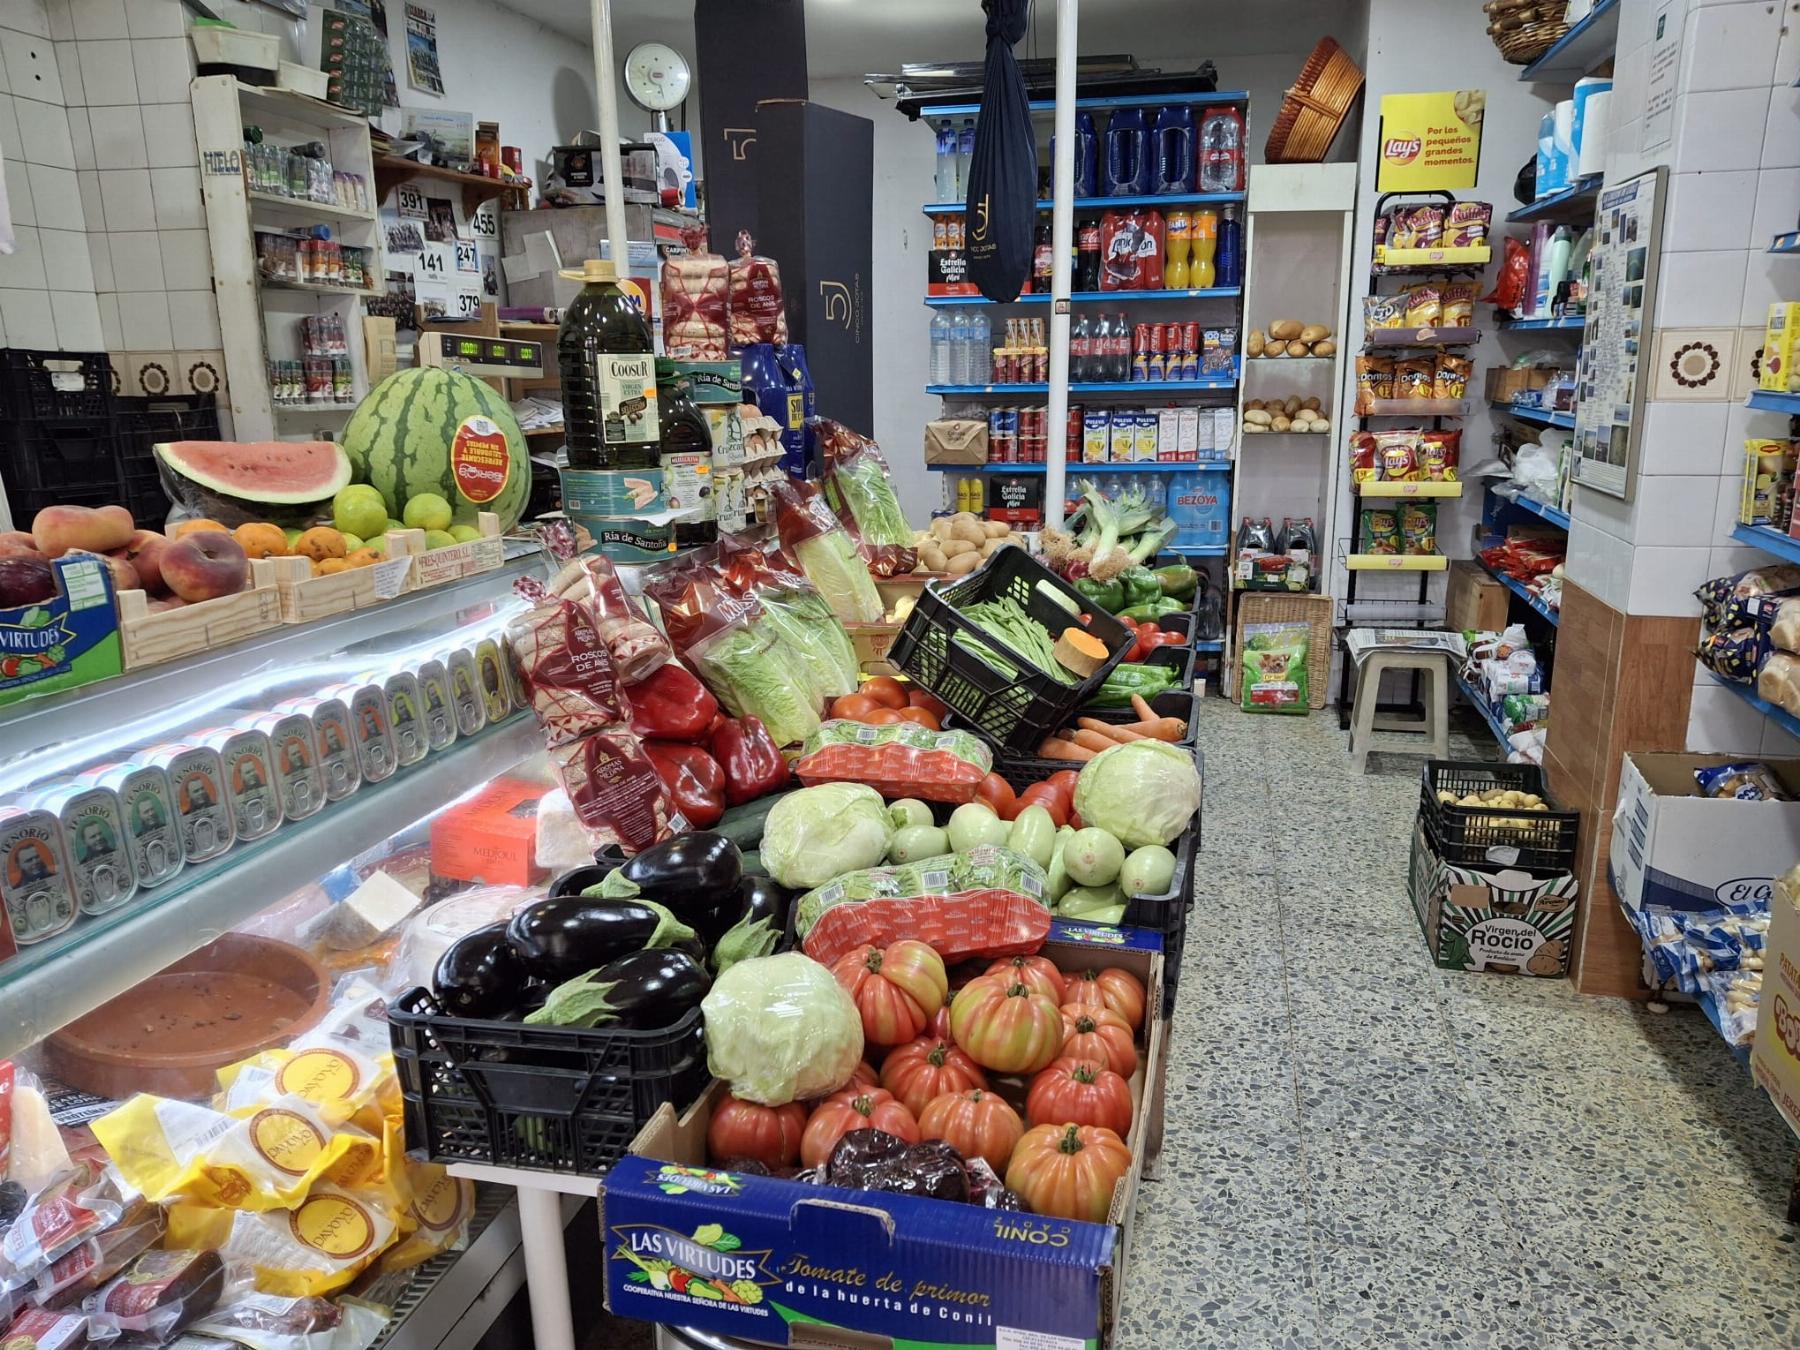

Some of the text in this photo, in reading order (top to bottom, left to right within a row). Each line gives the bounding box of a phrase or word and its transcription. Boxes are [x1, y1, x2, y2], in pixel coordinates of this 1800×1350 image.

[1427, 126, 1458, 135] Por los
[1385, 138, 1420, 157] Lay's
[1427, 136, 1471, 147] pequeños
[1425, 147, 1463, 157] grandes
[400, 191, 423, 210] 391
[473, 214, 496, 235] 455
[419, 251, 444, 272] 141
[457, 247, 477, 263] 247
[940, 258, 966, 266] Estrella
[941, 266, 965, 274] Galicia
[459, 294, 480, 312] 379
[611, 361, 648, 377] COOSUR
[1001, 486, 1026, 494] Estrella
[1177, 496, 1217, 505] BEZOYA
[622, 532, 634, 543] de
[0, 624, 60, 648] VIRTUDES
[571, 649, 608, 663] ROSCOS
[576, 661, 594, 672] DE
[127, 782, 161, 805] TENORIO
[70, 805, 110, 831] TENORIO
[3, 828, 49, 854] TENORIO
[1730, 885, 1752, 900] El
[1485, 925, 1537, 937] Virgen del
[994, 1224, 1068, 1247] CONIL
[631, 1232, 756, 1279] LAS VIRTUDES
[781, 1253, 992, 1307] Tomate de primor
[623, 1284, 664, 1298] COOPERATIVA
[664, 1291, 691, 1303] NUESTRA
[692, 1296, 718, 1308] SEÑORA
[727, 1303, 739, 1312] LAS
[740, 1305, 769, 1317] VIRTUDES
[785, 1281, 992, 1326] de la huerta de Conil
